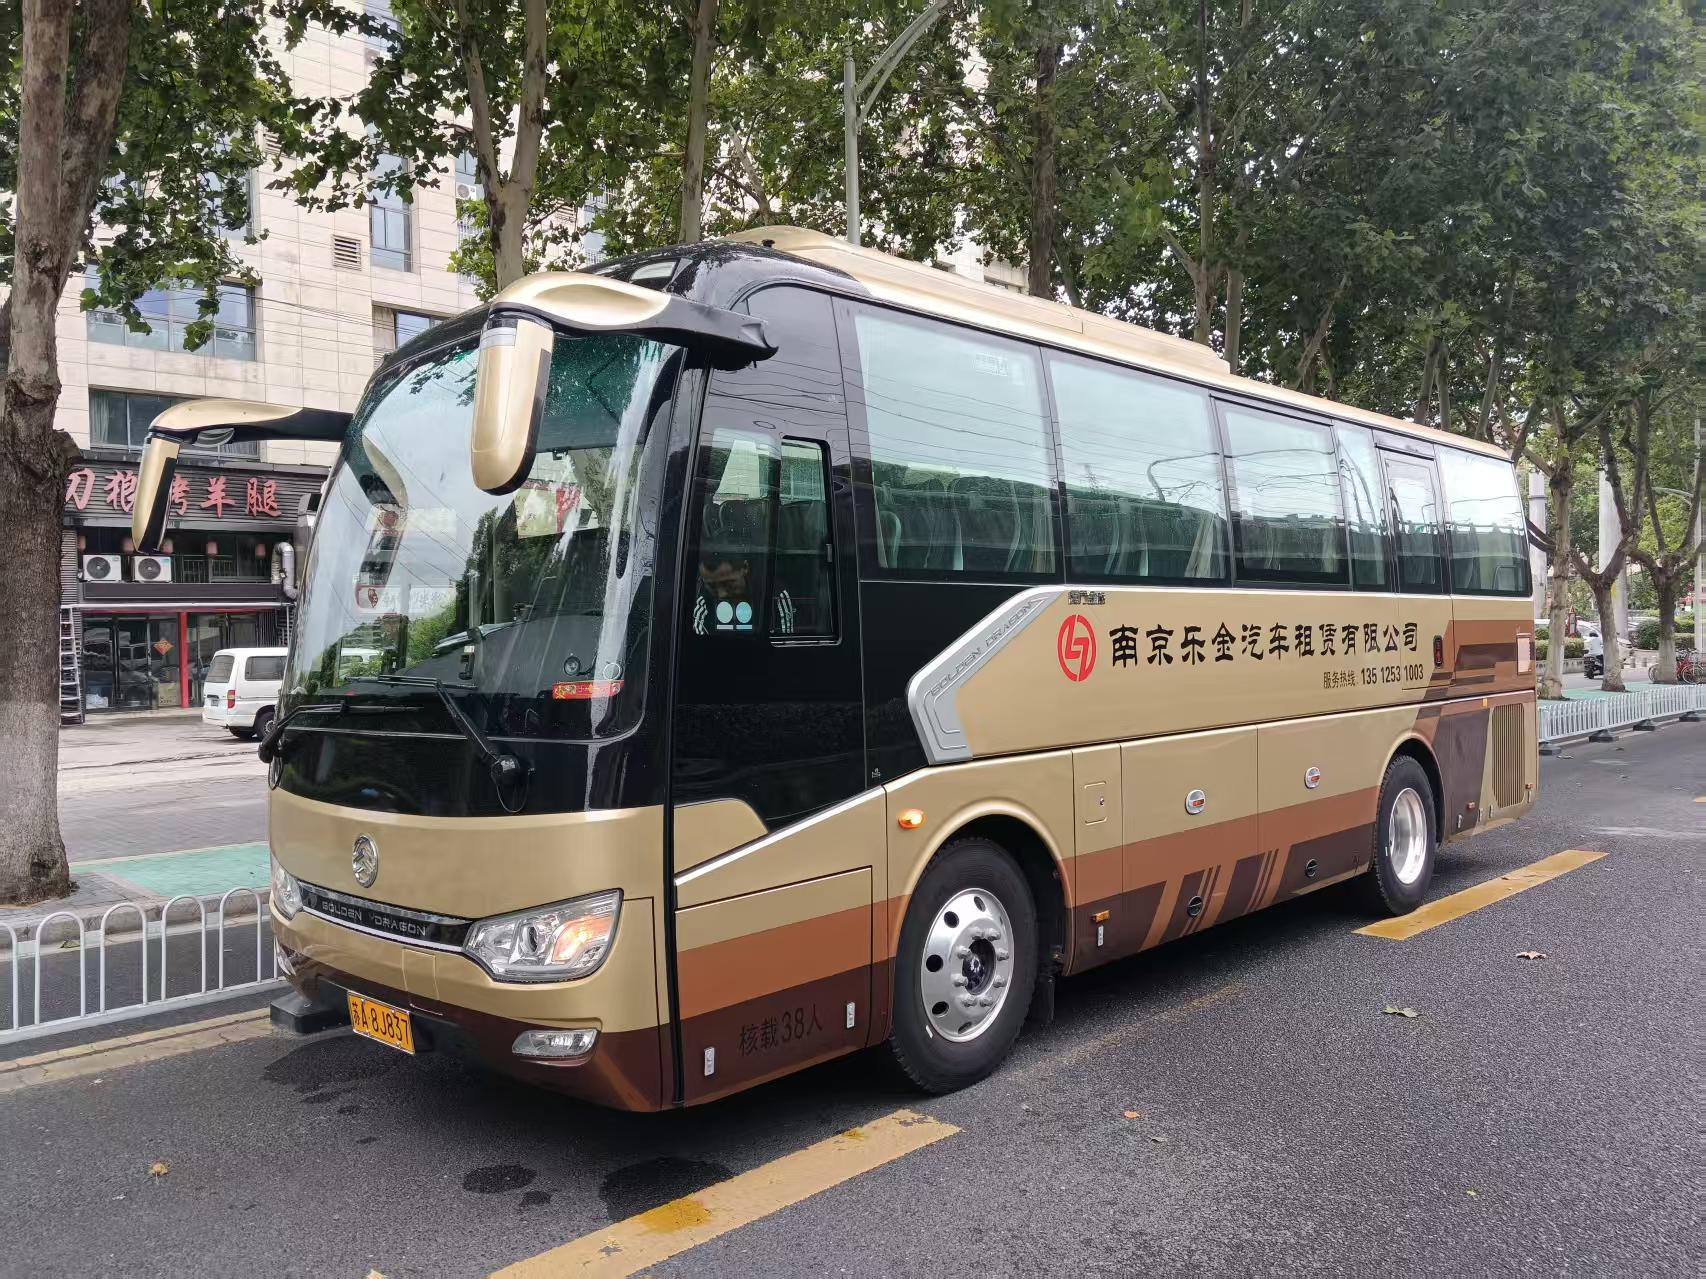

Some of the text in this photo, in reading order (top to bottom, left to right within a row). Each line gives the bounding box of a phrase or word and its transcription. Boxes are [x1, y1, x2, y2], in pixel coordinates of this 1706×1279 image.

[1109, 621, 1418, 668] 南京乐金汽车租赁有限公司
[1361, 668, 1377, 685] 135
[1380, 666, 1400, 684] 1253
[1404, 664, 1424, 681] 1003
[322, 901, 426, 936] GOLDEN DRAGON
[738, 1003, 823, 1057] 核载38人
